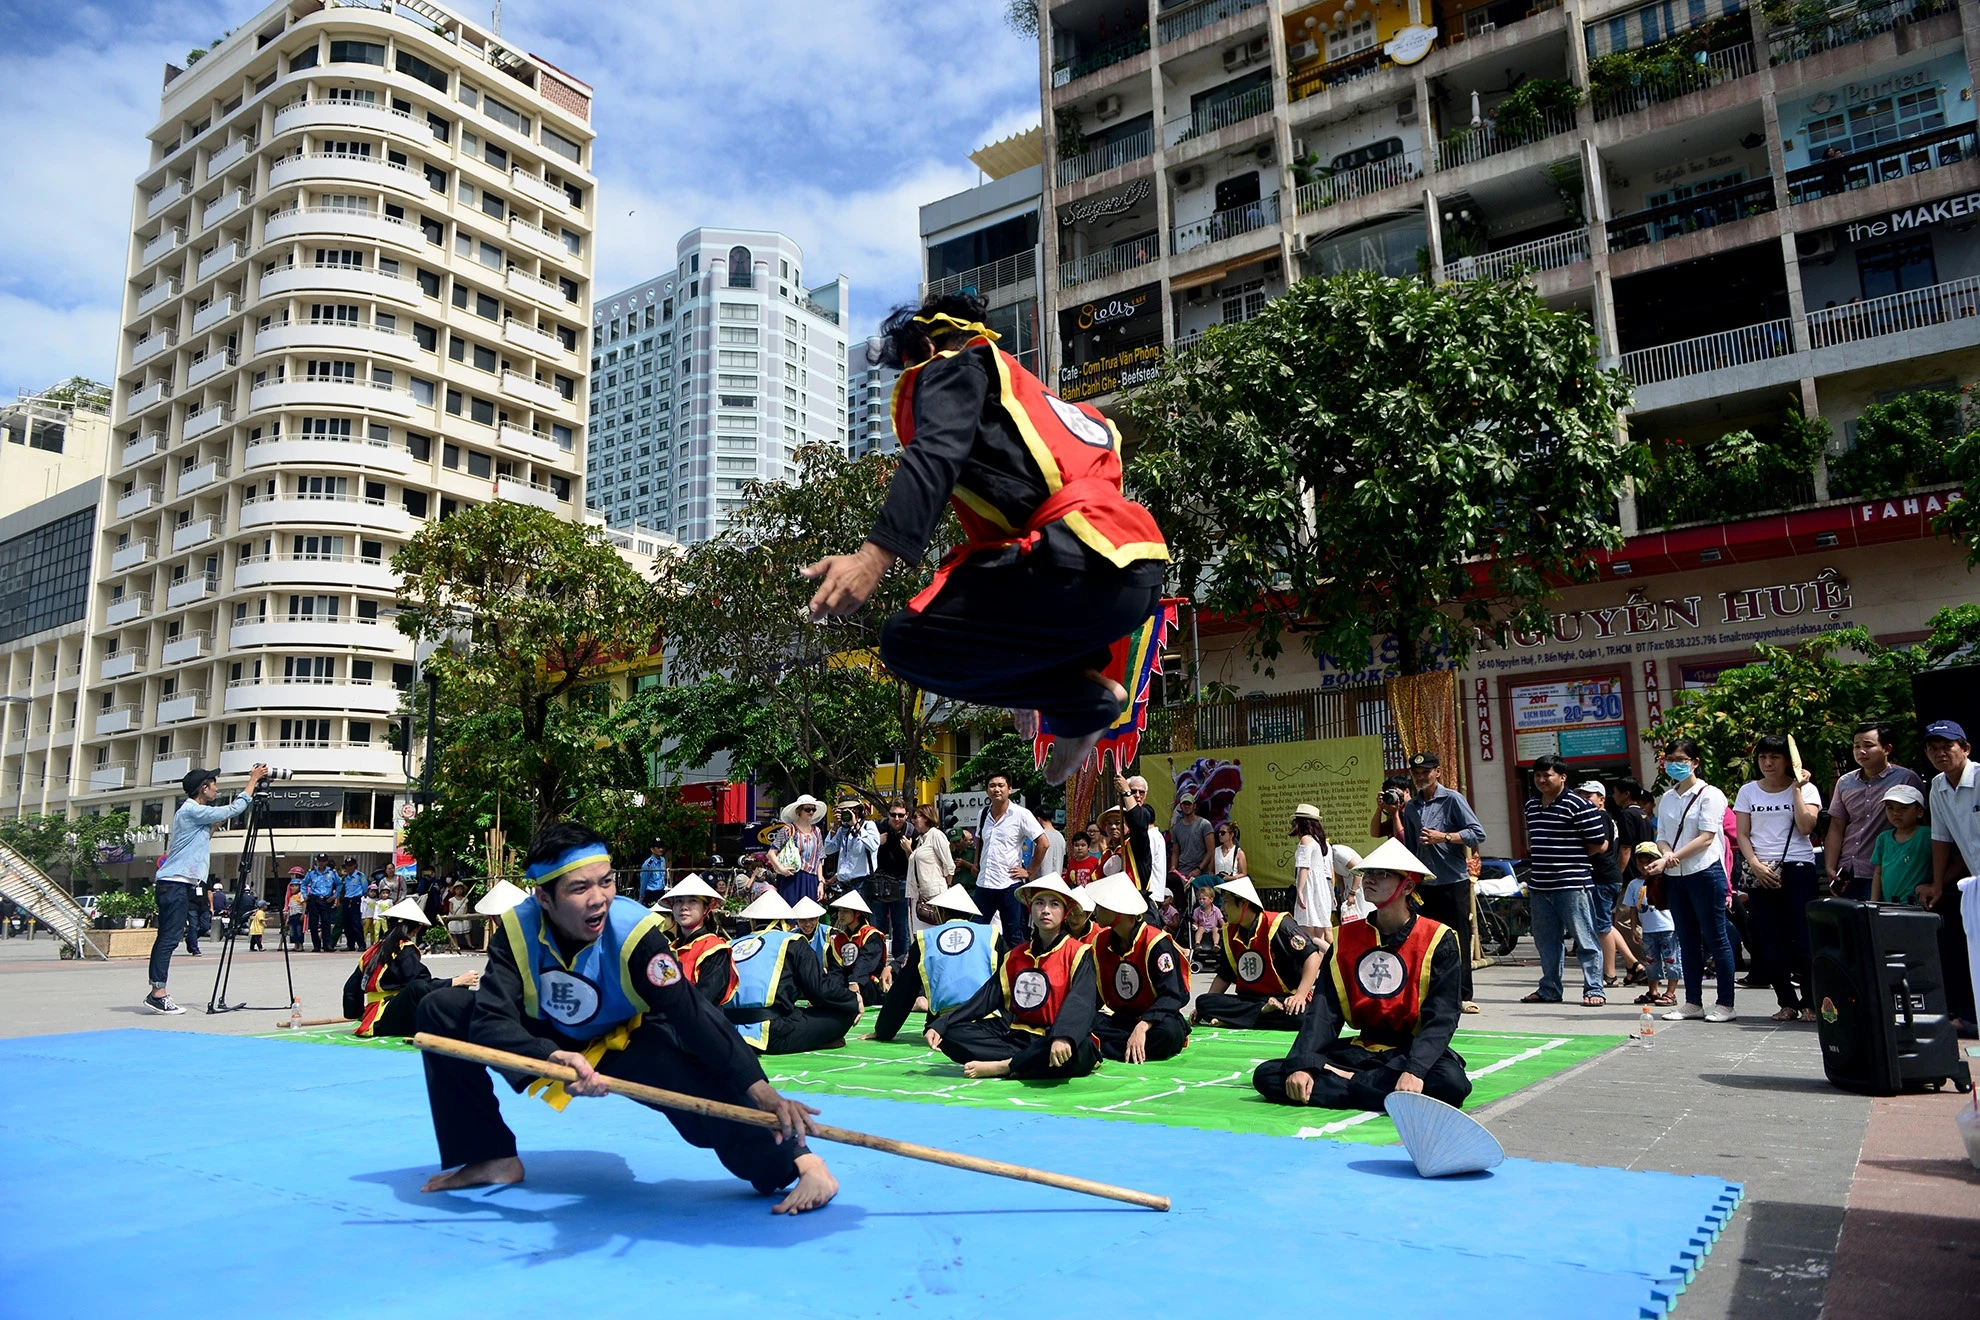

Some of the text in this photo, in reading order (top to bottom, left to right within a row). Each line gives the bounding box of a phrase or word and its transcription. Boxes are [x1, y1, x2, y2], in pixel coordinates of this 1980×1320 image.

[1844, 68, 1930, 106] Partea
[1846, 193, 1980, 242] the MAKER
[1061, 365, 1079, 382] Cafe
[1718, 567, 1853, 624] HUỆ
[1606, 645, 1632, 656] TP.HCM
[1665, 634, 1717, 649] 08.38.225.796
[1529, 694, 1548, 705] 2017
[1539, 709, 1556, 718] BLOC
[1476, 680, 1492, 759] FAHASA
[547, 981, 581, 1018] 馬
